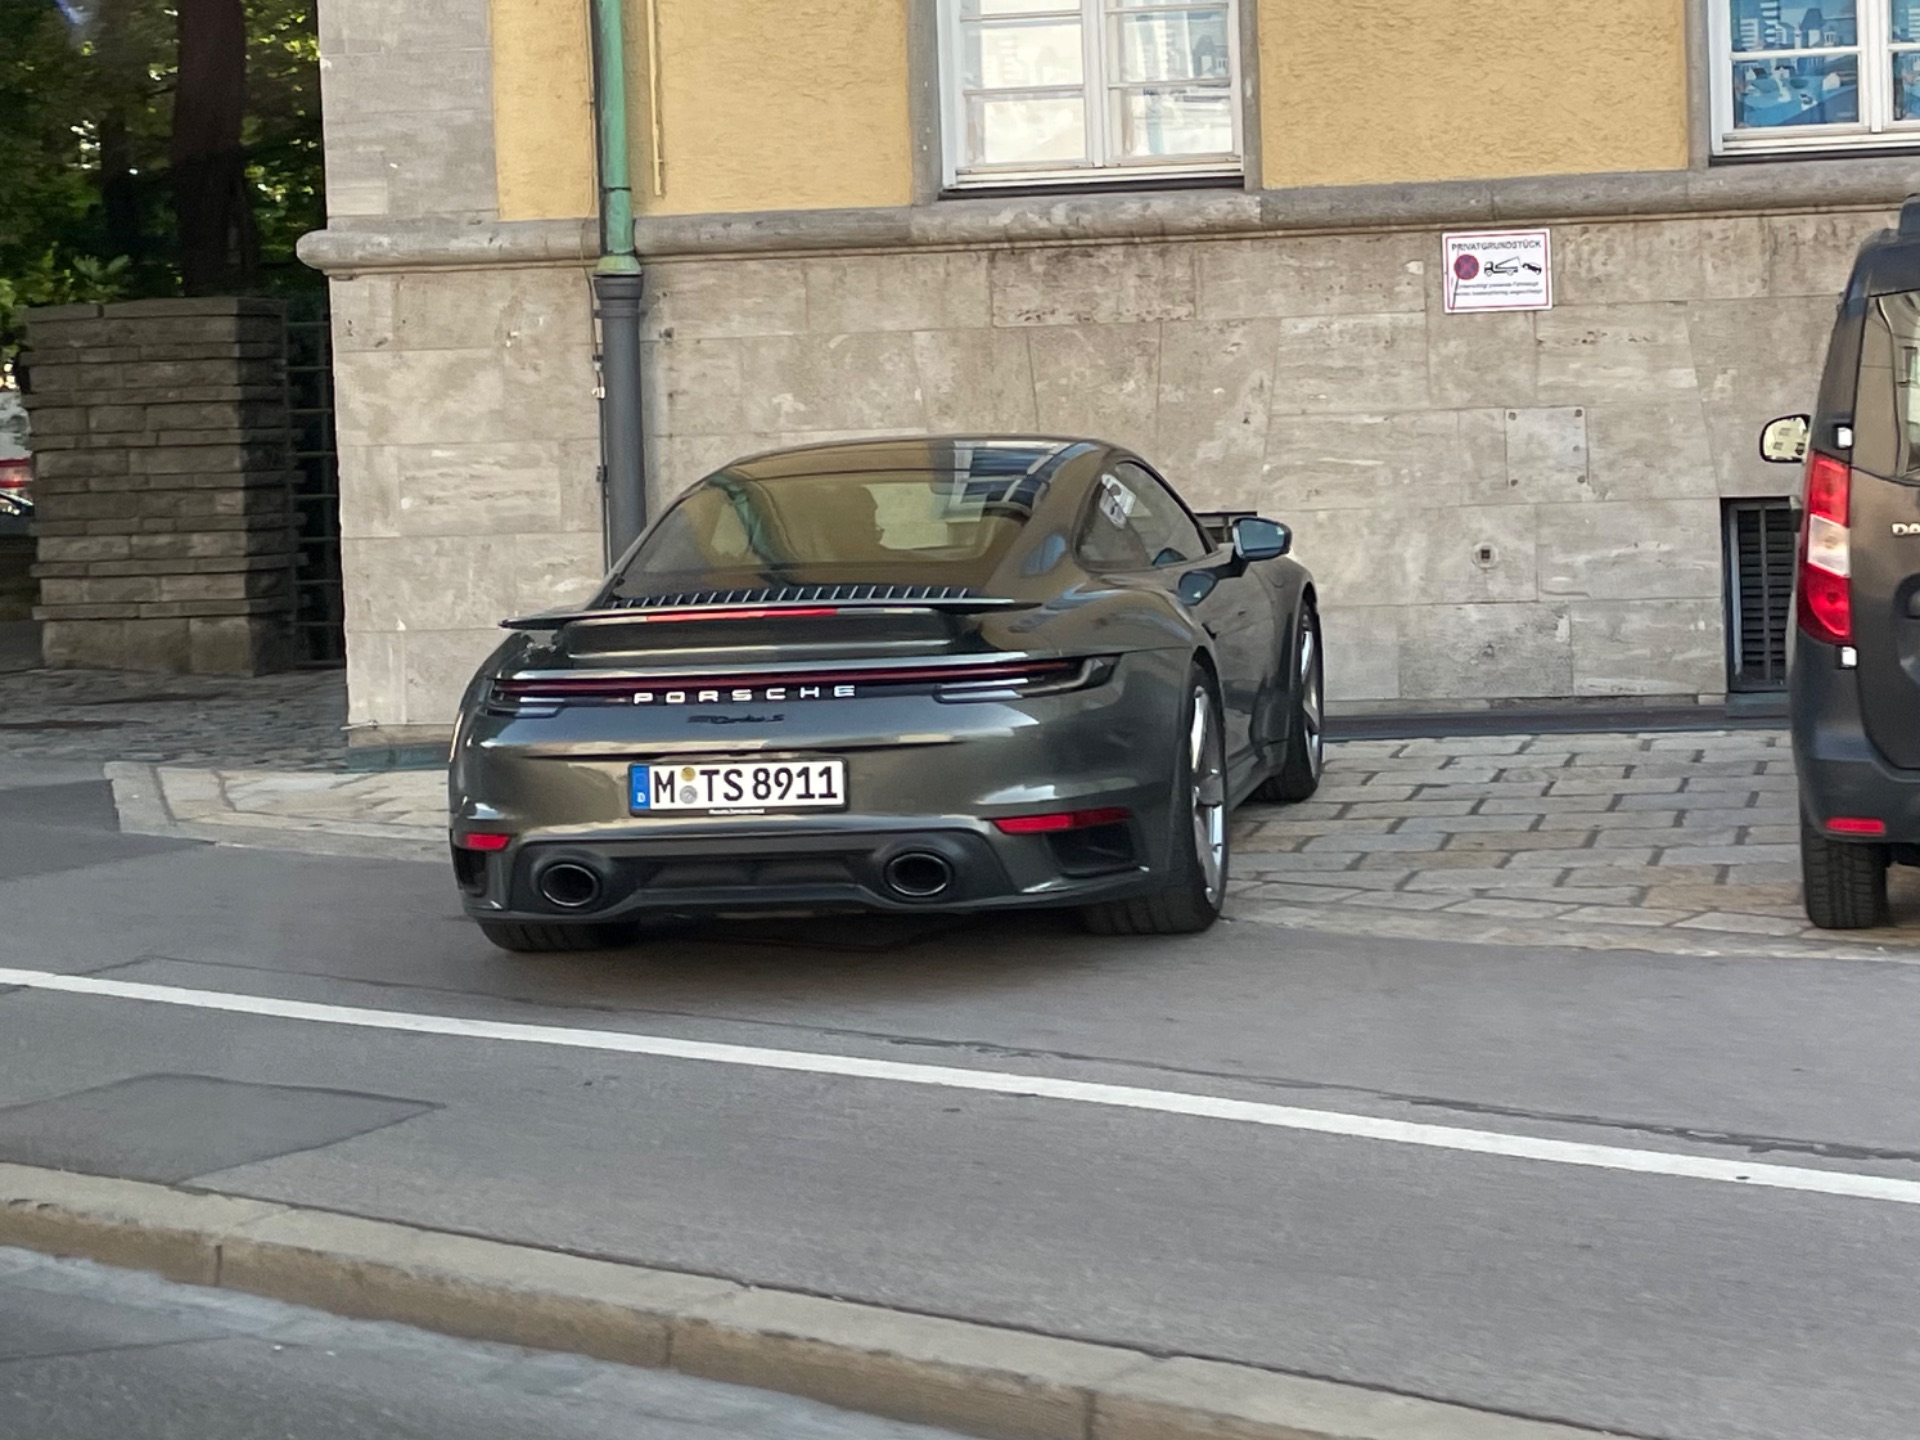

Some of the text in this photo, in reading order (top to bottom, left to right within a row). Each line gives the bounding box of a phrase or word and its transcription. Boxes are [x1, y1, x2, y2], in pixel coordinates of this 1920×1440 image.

[1451, 239, 1542, 252] PRIVATGRUNDSTÜCK
[633, 685, 855, 705] PORSCHE
[654, 766, 837, 804] M TS 8911
[636, 792, 646, 803] D
